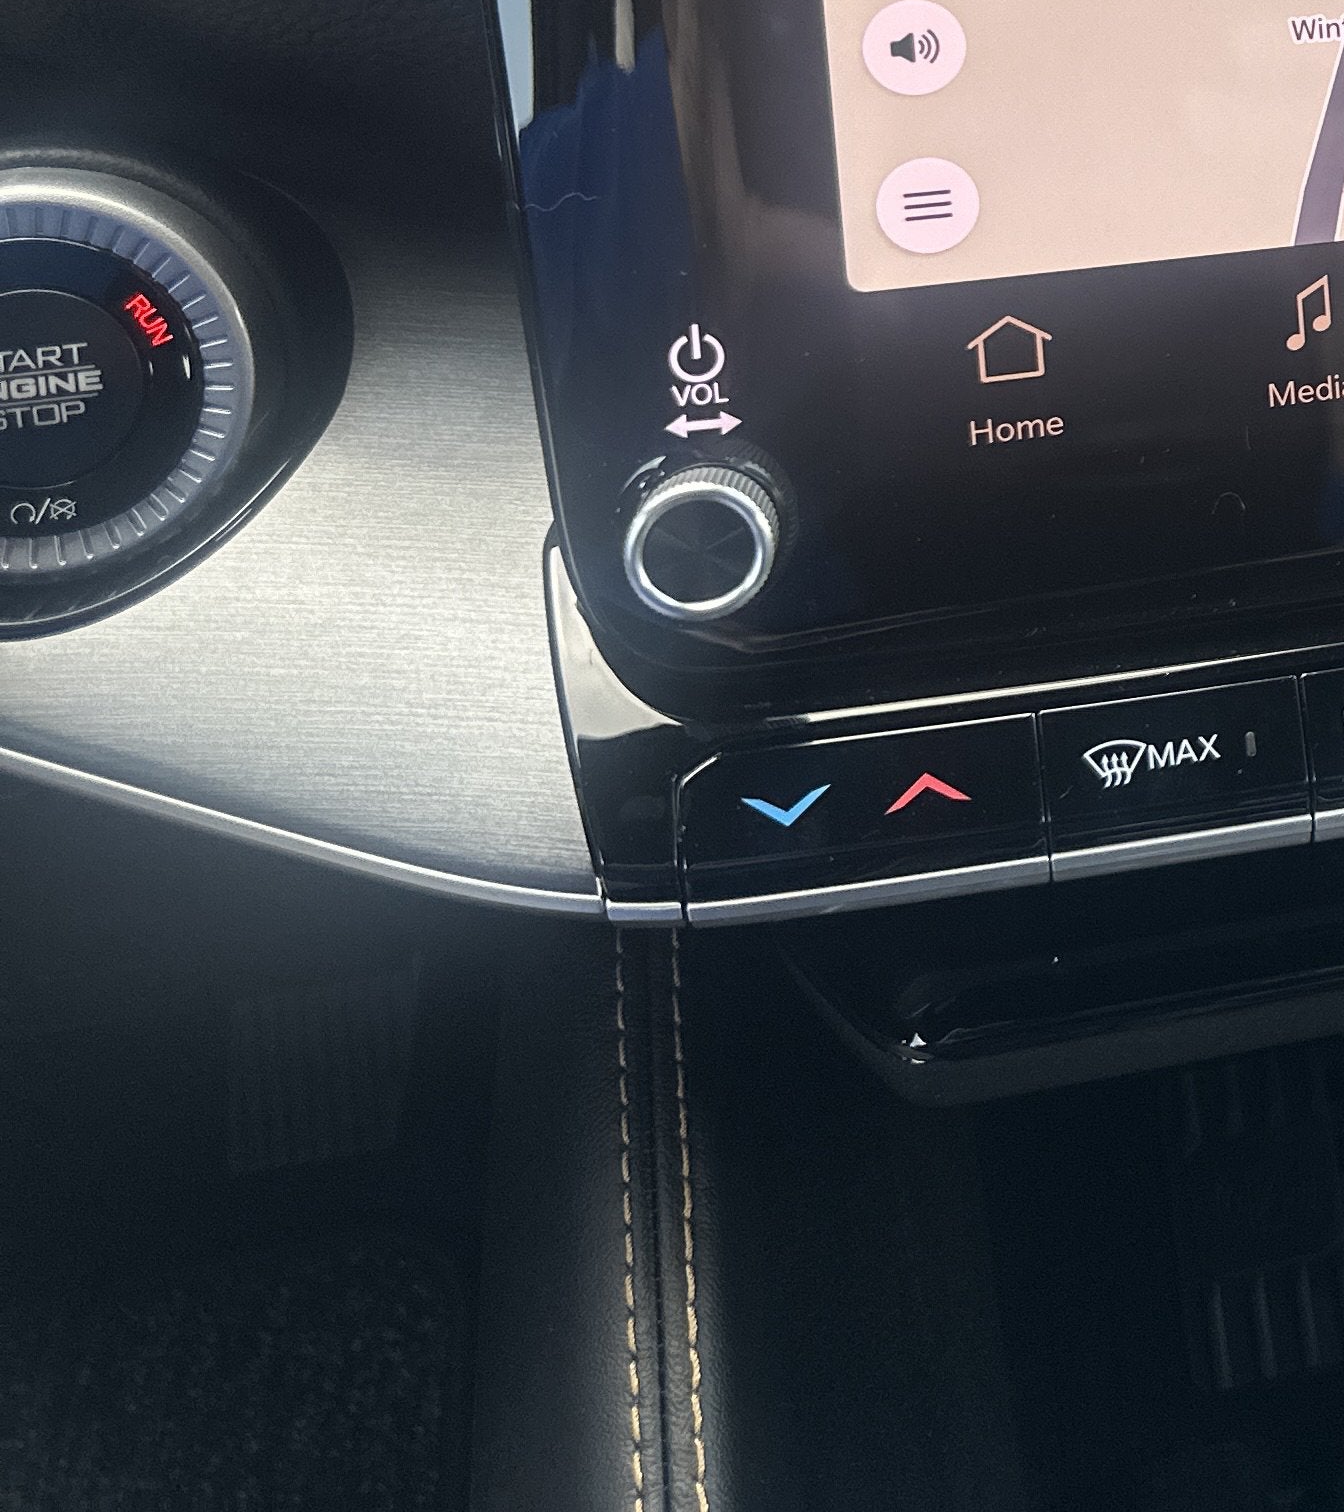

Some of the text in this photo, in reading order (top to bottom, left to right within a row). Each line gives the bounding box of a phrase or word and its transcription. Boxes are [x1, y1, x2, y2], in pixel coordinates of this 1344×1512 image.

[123, 292, 174, 348] RUN
[671, 382, 730, 408] VOL
[968, 411, 1065, 447] Home
[1147, 733, 1222, 769] MAX
